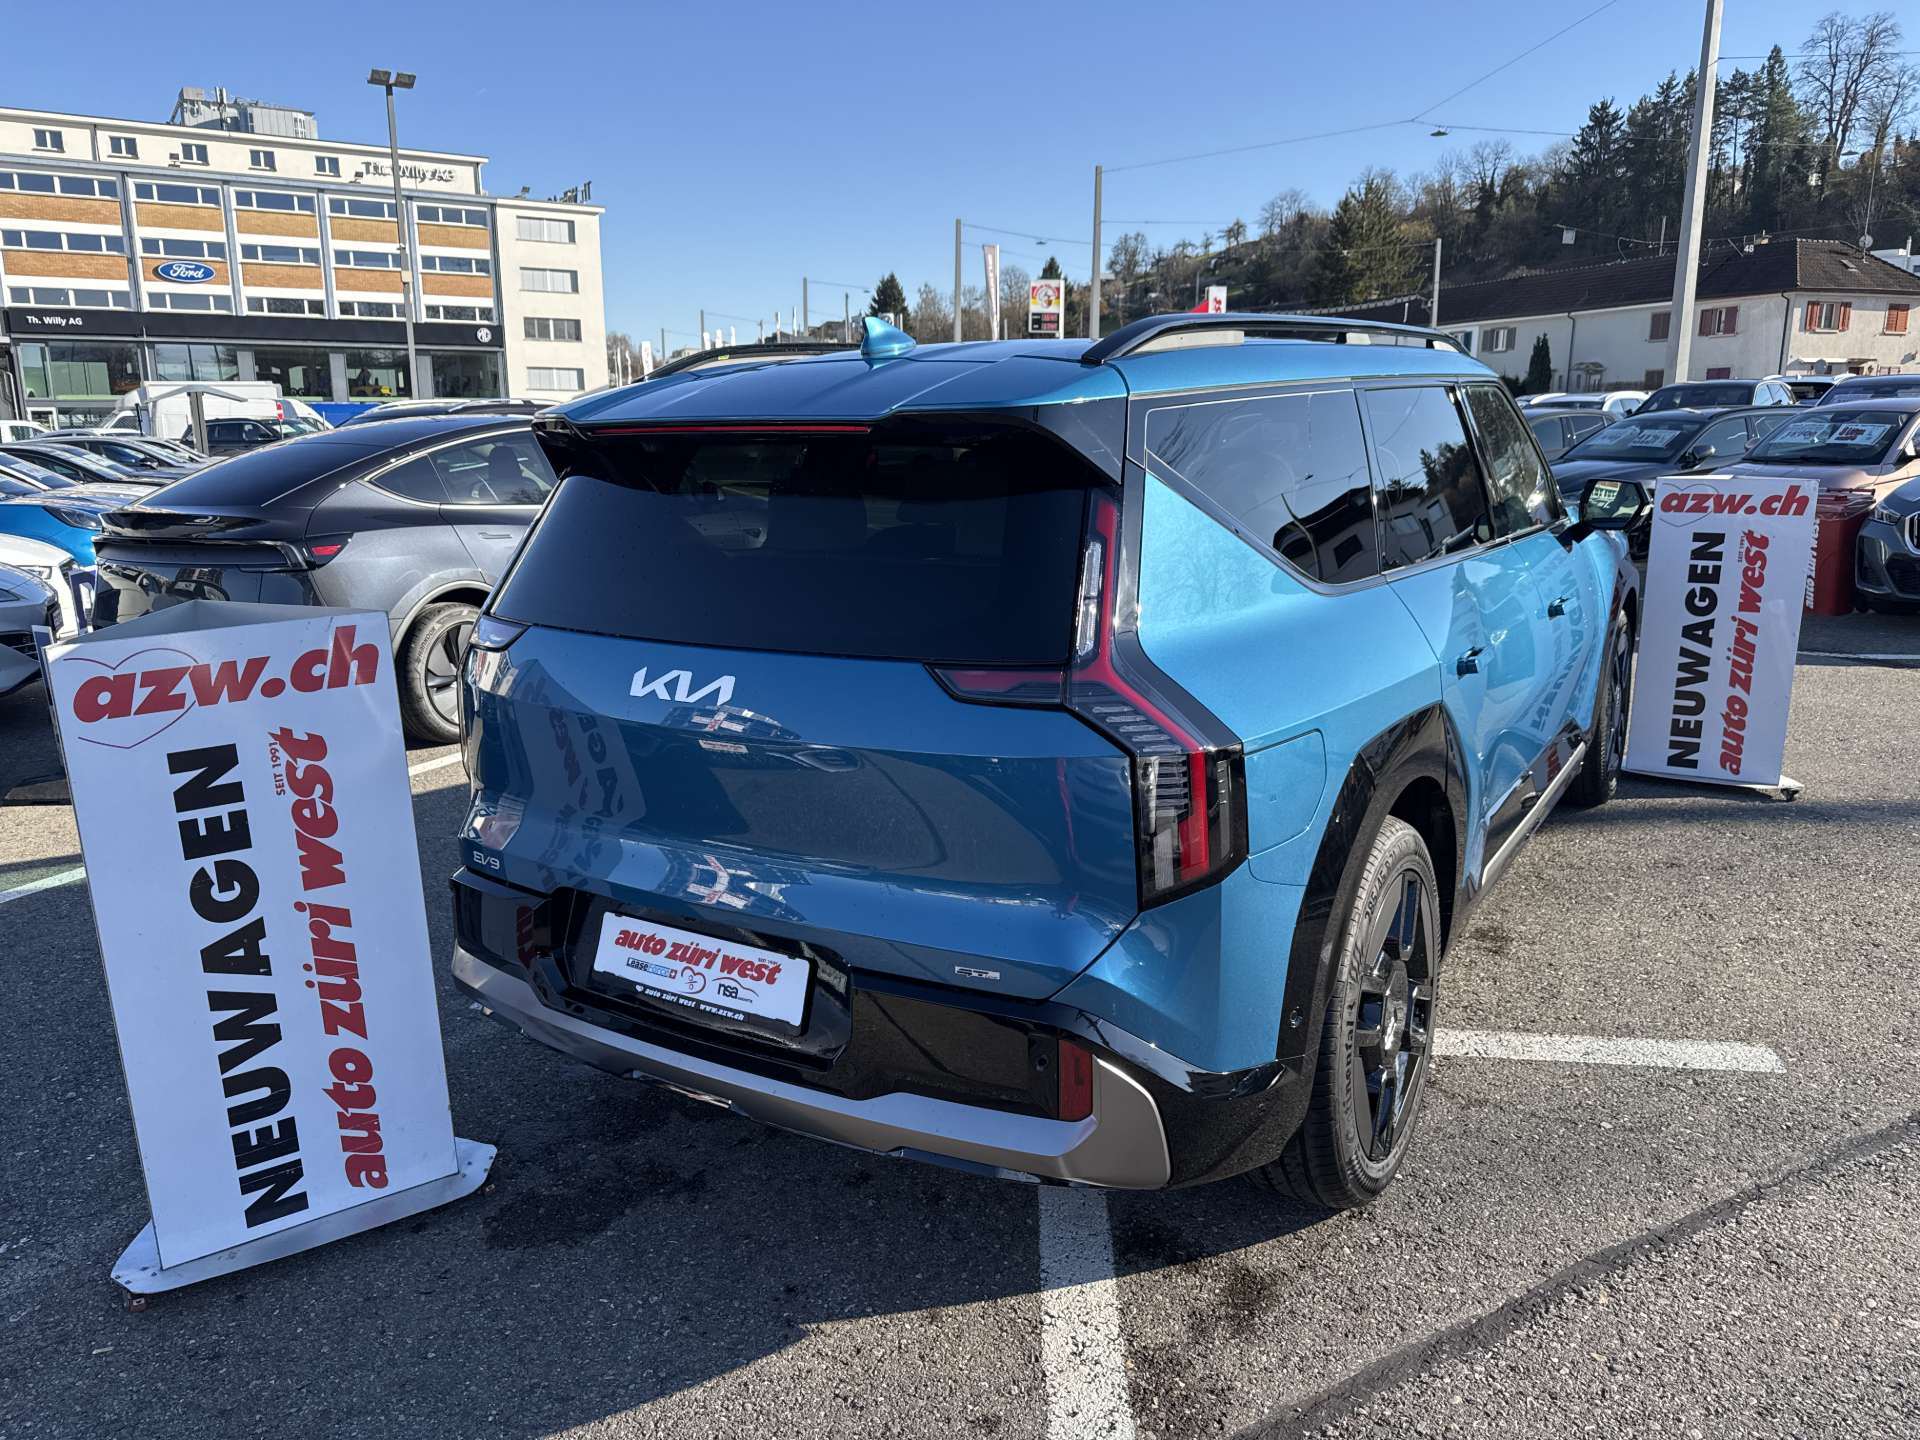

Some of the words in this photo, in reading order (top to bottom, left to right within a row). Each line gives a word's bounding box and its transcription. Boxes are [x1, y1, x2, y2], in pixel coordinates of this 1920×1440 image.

[169, 262, 205, 280] Ford
[26, 315, 41, 325] Th.
[43, 316, 67, 327] Willy
[69, 317, 83, 326] AG
[1660, 485, 1811, 516] azw.ch
[1738, 529, 1770, 614] west
[73, 626, 380, 724] azw.ch
[1667, 532, 1726, 770] NEUWAGEN
[1726, 615, 1761, 697] züri
[629, 666, 737, 706] KIA
[269, 741, 282, 768] 1991
[1720, 696, 1749, 776] auto
[267, 726, 347, 893] west
[273, 773, 286, 796] SEIT
[472, 850, 500, 870] EV9
[293, 900, 369, 1038] züri
[614, 929, 667, 956] auto
[665, 941, 722, 970] züri
[719, 954, 783, 985] west
[167, 743, 309, 1234] NEUWAGEN
[644, 987, 661, 999] auto
[661, 992, 678, 1004] züri
[678, 996, 696, 1008] west
[717, 982, 739, 1000] nsa
[321, 1046, 389, 1190] auto
